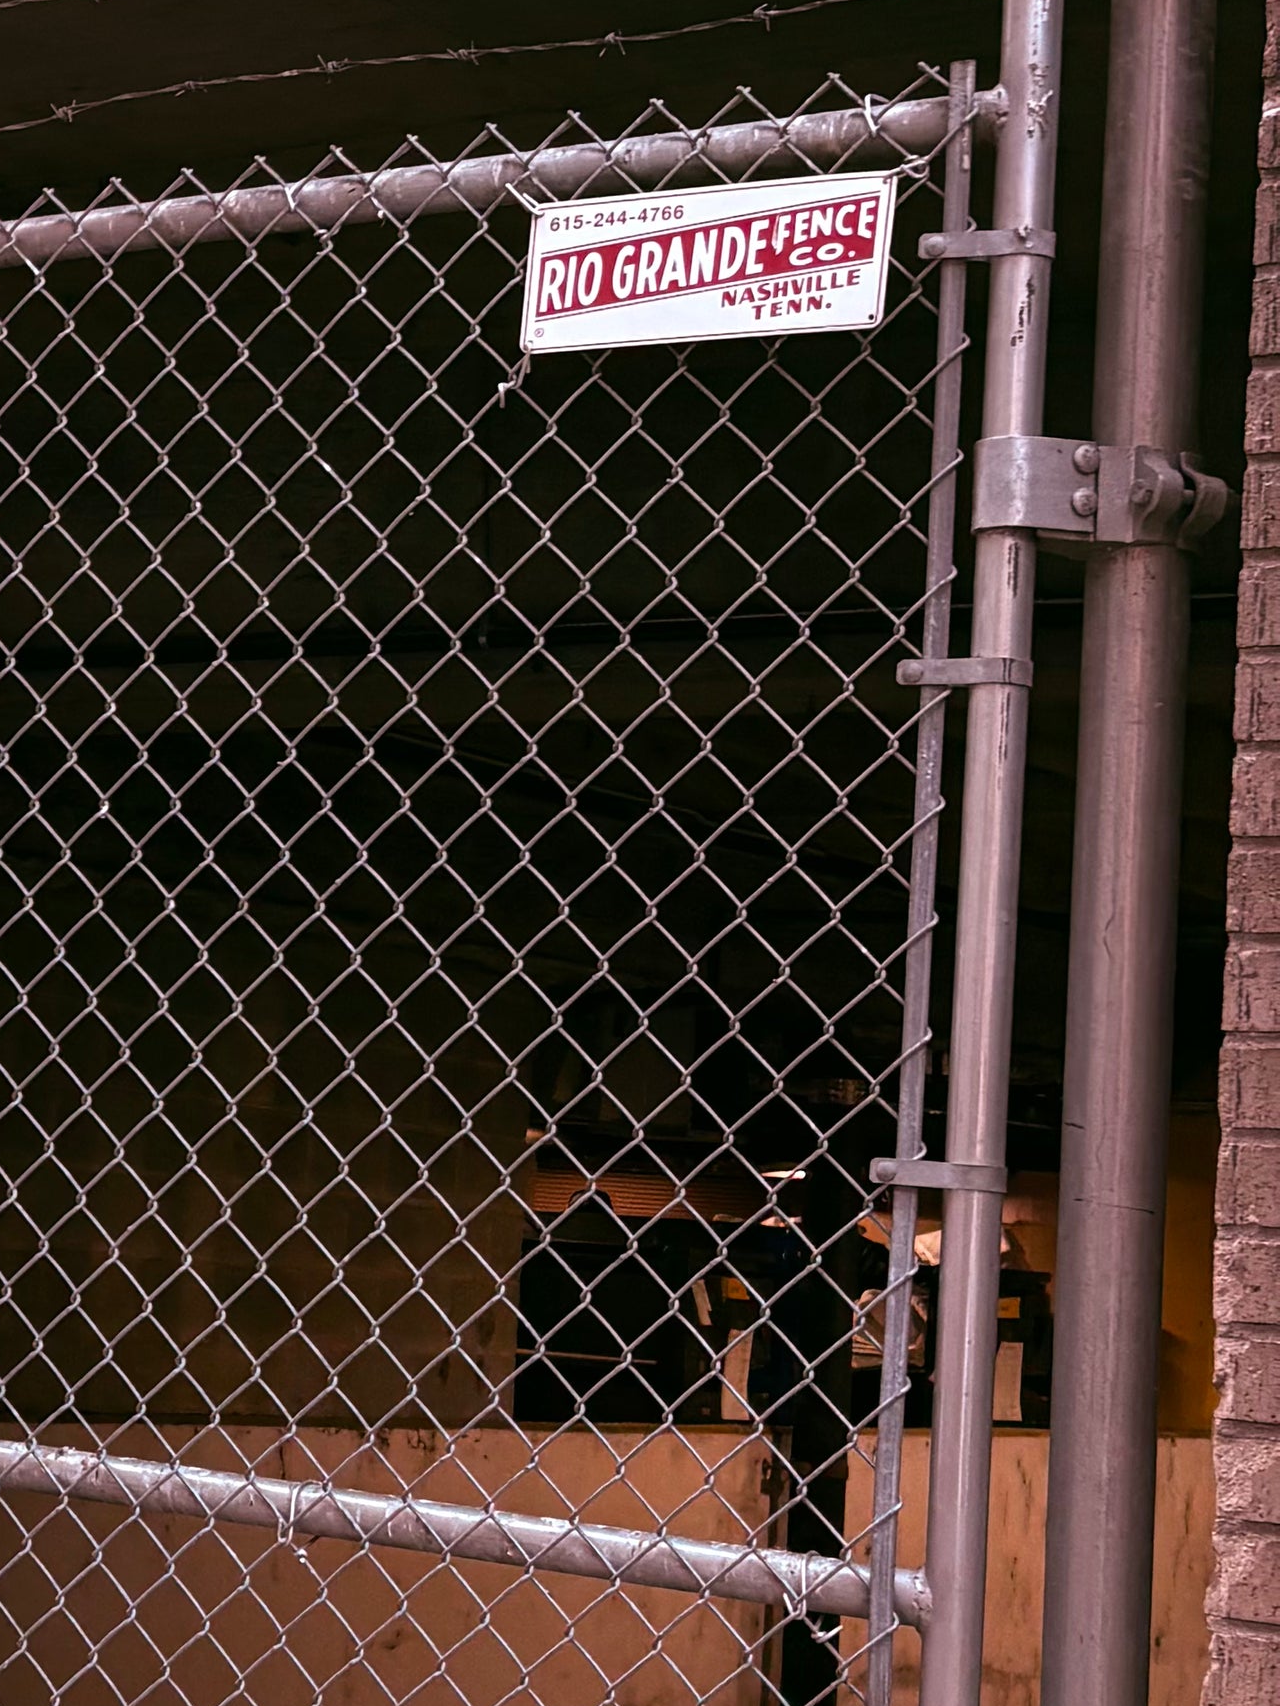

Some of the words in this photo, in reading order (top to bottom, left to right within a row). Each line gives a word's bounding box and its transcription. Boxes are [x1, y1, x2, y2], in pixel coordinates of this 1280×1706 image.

[549, 204, 685, 232] 615-244-4766
[539, 251, 602, 313] RIO
[611, 218, 770, 300] GRANDE
[772, 200, 878, 253] FENCE
[788, 242, 856, 266] CO.
[720, 268, 861, 309] NASHVILLE
[751, 294, 832, 321] TENN.
